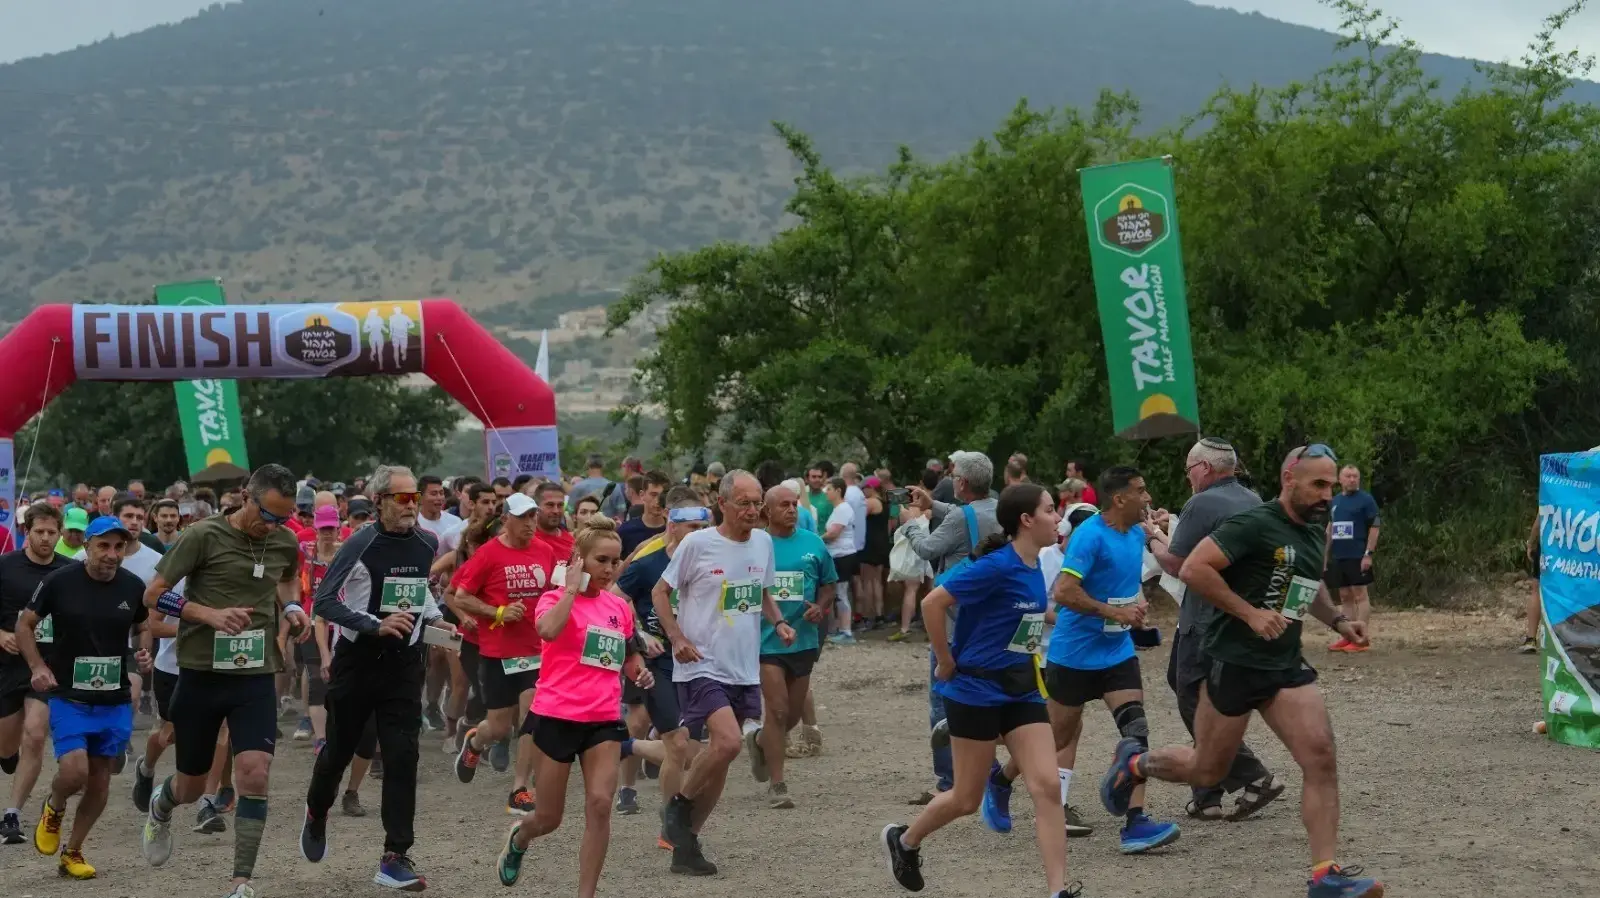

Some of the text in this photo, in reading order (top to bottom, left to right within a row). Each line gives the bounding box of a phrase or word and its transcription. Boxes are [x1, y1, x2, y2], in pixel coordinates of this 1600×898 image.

[1118, 228, 1152, 241] TAVOR
[1120, 262, 1163, 391] TAVOR
[1149, 264, 1176, 382] HALF MARATHON
[83, 312, 272, 369] FINISH
[301, 349, 337, 359] TAVOR
[191, 379, 222, 446] TAVO
[519, 452, 557, 463] MARATHON
[516, 461, 545, 472] ISRAEL
[1539, 504, 1600, 557] TAVO
[504, 564, 527, 574] RUN
[1551, 556, 1600, 582] MARATH
[507, 579, 537, 589] LIVES
[774, 577, 795, 588] 664
[1263, 565, 1290, 611] AVOR
[395, 584, 416, 598] 583
[734, 585, 753, 600] 601
[229, 639, 253, 653] 644
[598, 636, 618, 653] 584
[90, 663, 108, 676] 771
